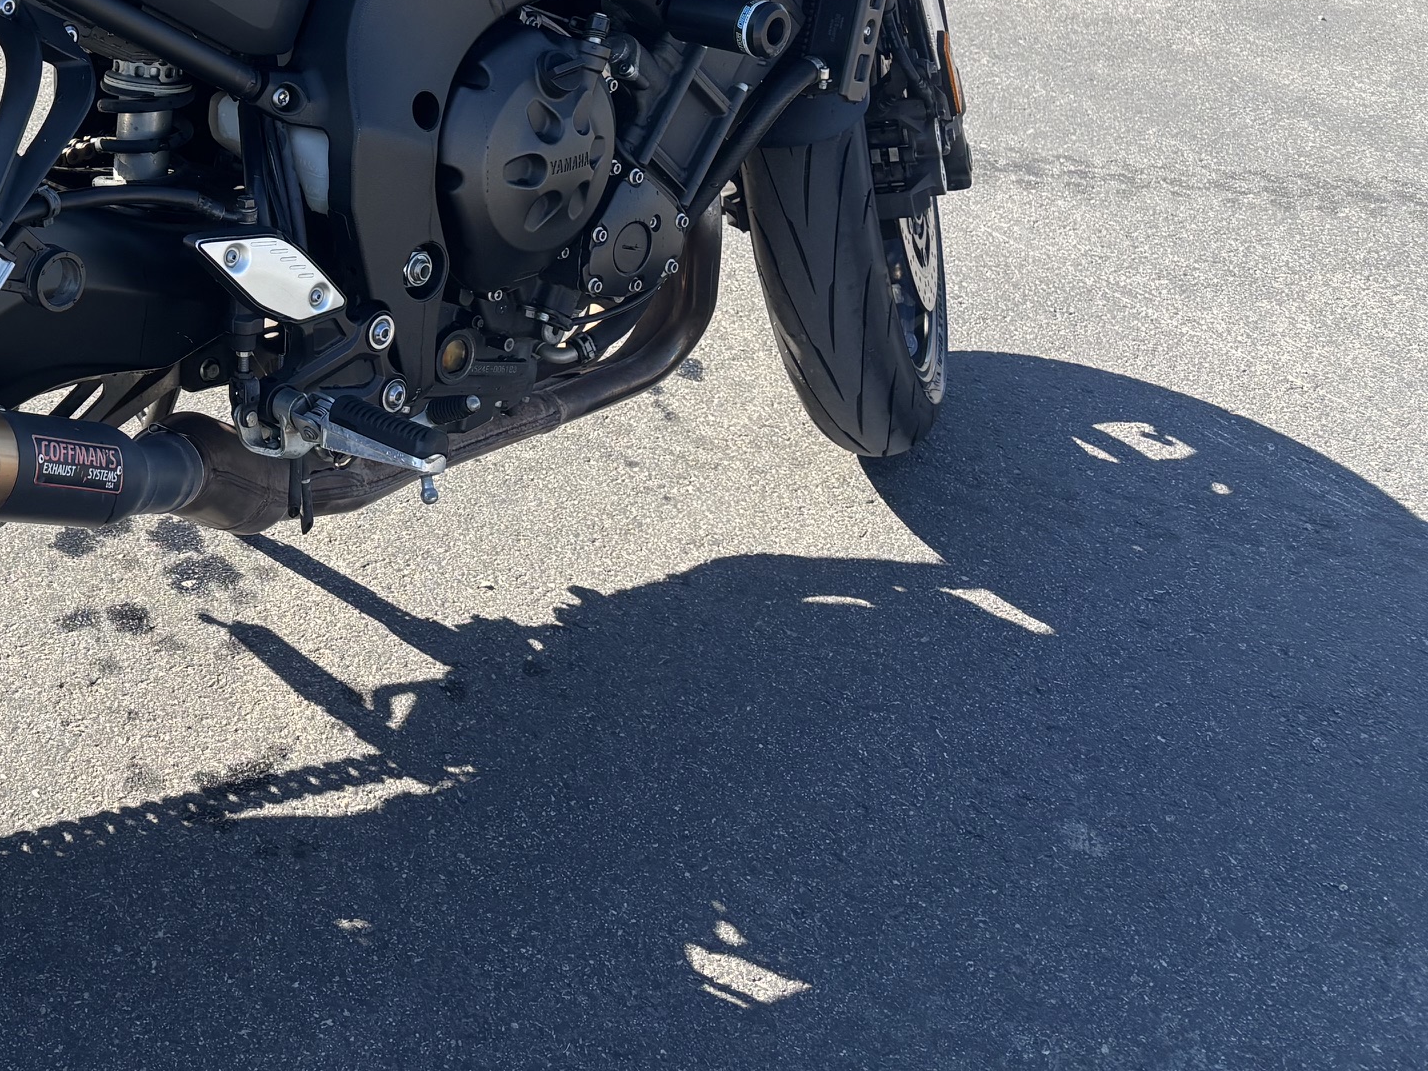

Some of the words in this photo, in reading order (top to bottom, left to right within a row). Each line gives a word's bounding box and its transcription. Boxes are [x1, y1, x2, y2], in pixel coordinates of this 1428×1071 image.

[549, 151, 589, 175] YAMAHA
[41, 440, 117, 469] COFFMAN'S
[42, 462, 77, 477] EXHAUST
[87, 468, 118, 482] SYSTEMS
